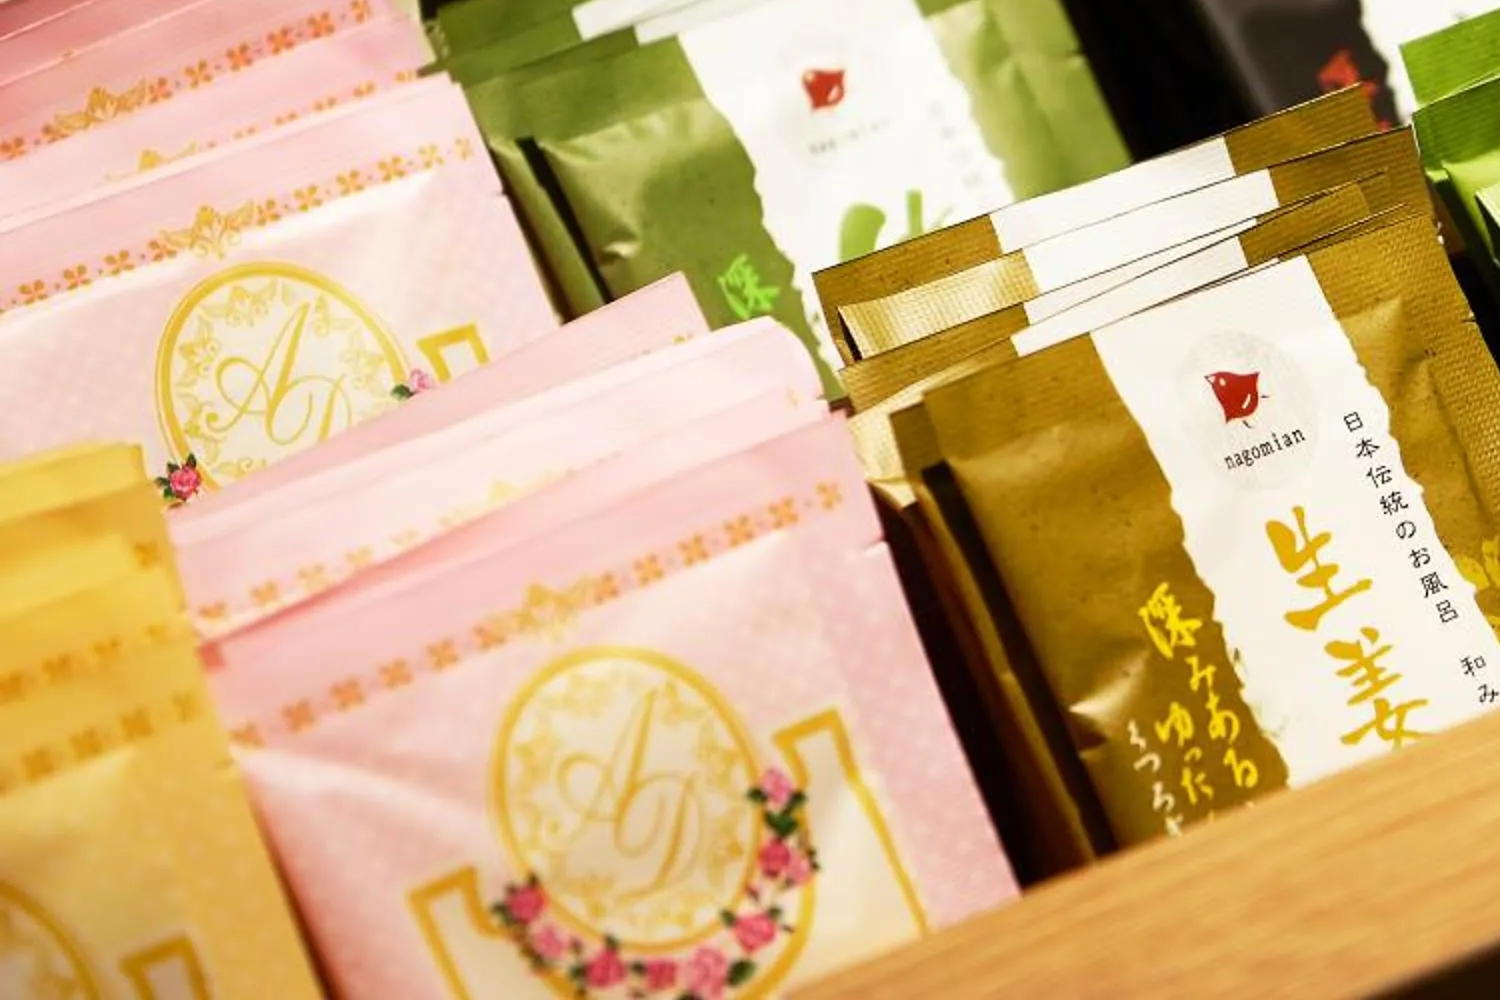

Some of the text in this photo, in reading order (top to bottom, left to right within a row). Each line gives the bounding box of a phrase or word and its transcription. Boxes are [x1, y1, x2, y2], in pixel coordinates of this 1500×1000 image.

[1224, 425, 1307, 471] nagomian
[1343, 411, 1460, 624] 日本伝統のお風呂
[1265, 506, 1430, 750] 生姜
